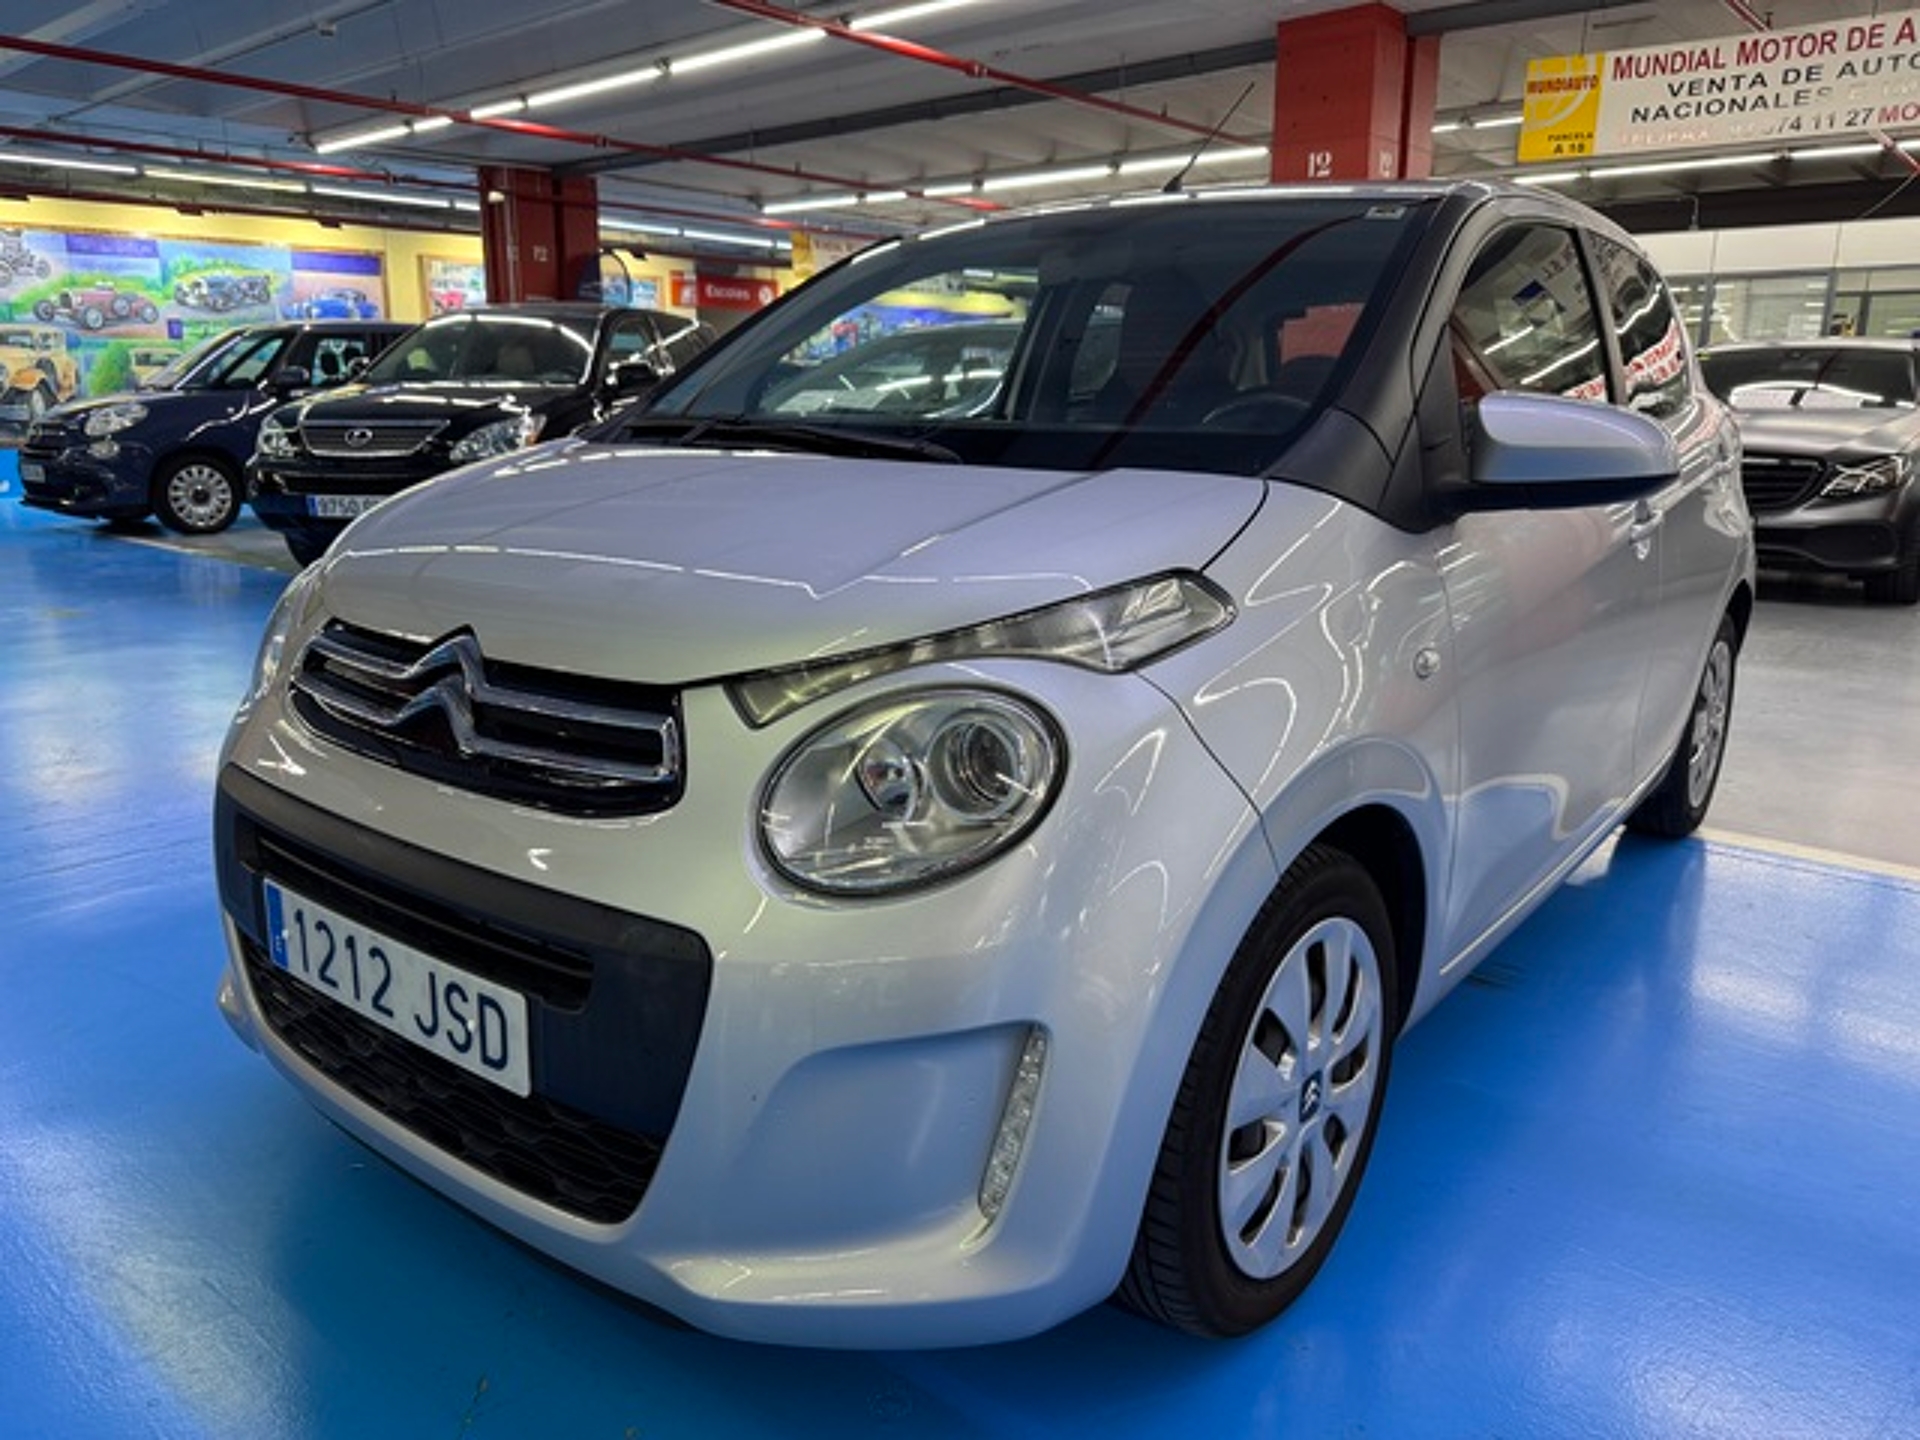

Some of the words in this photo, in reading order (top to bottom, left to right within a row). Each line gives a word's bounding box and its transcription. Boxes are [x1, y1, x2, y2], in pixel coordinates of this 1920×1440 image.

[1613, 46, 1726, 81] MUNDIAL
[1736, 29, 1837, 66] MOTOR
[1846, 23, 1885, 52] DE
[1893, 17, 1917, 45] A
[1667, 72, 1768, 98] VENTA
[1781, 63, 1824, 85] DE
[1835, 50, 1920, 80] AUTO
[1844, 107, 1875, 127] 27
[1307, 151, 1332, 179] 12
[294, 908, 395, 1019] 1212
[413, 970, 508, 1071] JSD
